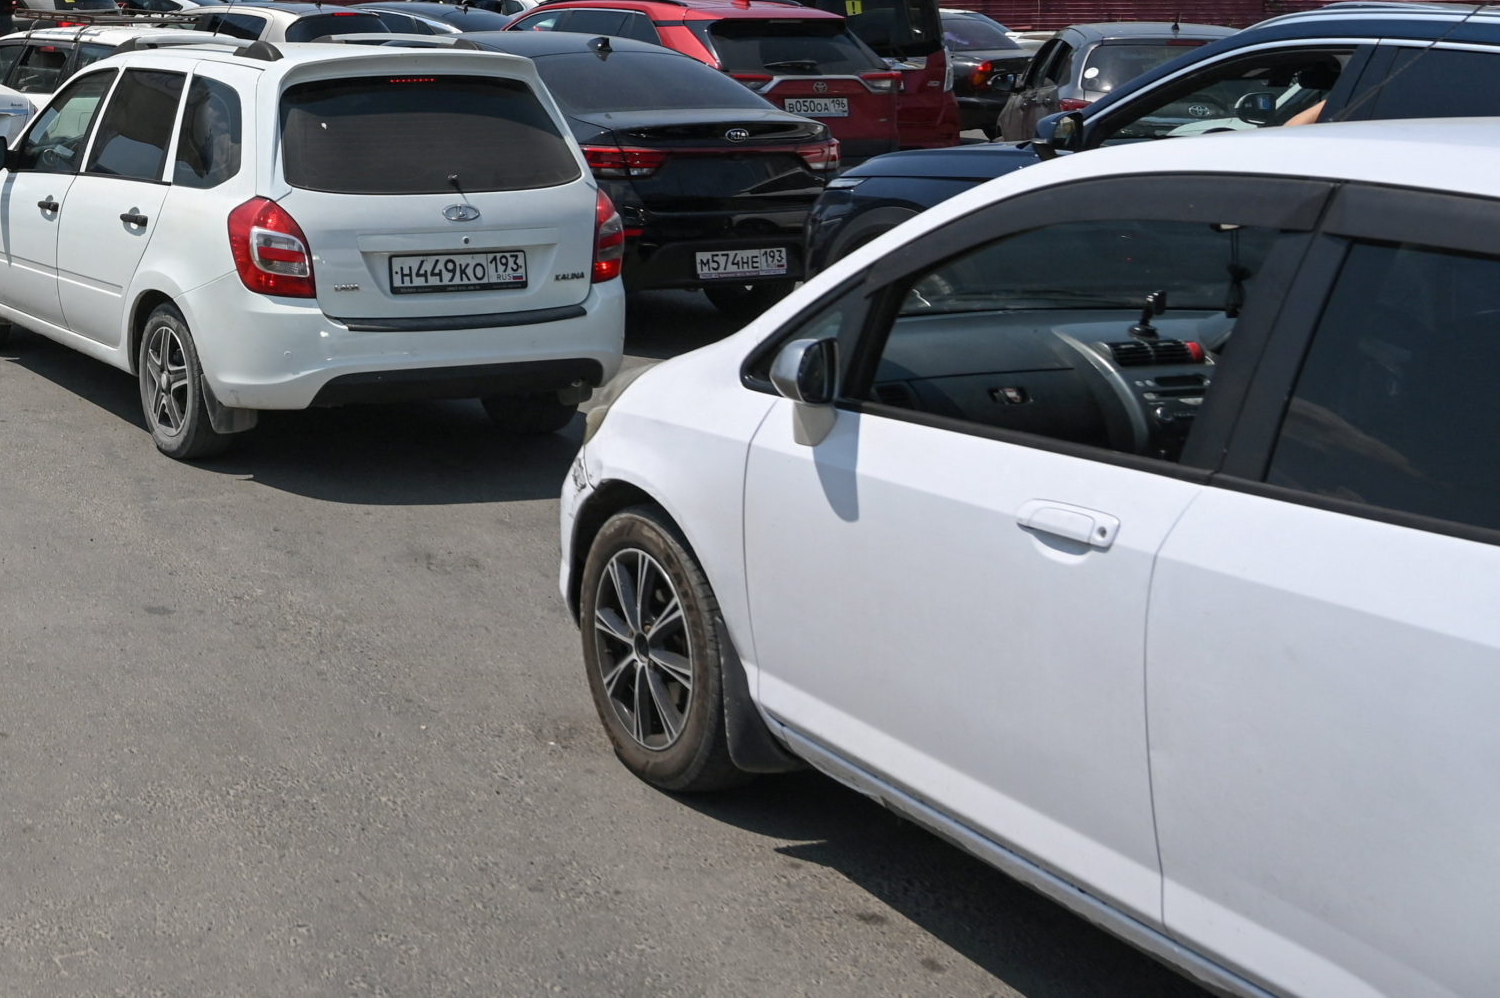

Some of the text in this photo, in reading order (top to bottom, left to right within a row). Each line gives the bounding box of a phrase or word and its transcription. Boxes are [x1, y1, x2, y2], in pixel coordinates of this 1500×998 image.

[788, 99, 846, 113] В050ОА 196
[700, 250, 784, 272] М574НЕ 193
[400, 254, 520, 285] Н449КО 193
[554, 271, 585, 282] KALINA
[496, 273, 512, 281] RUS
